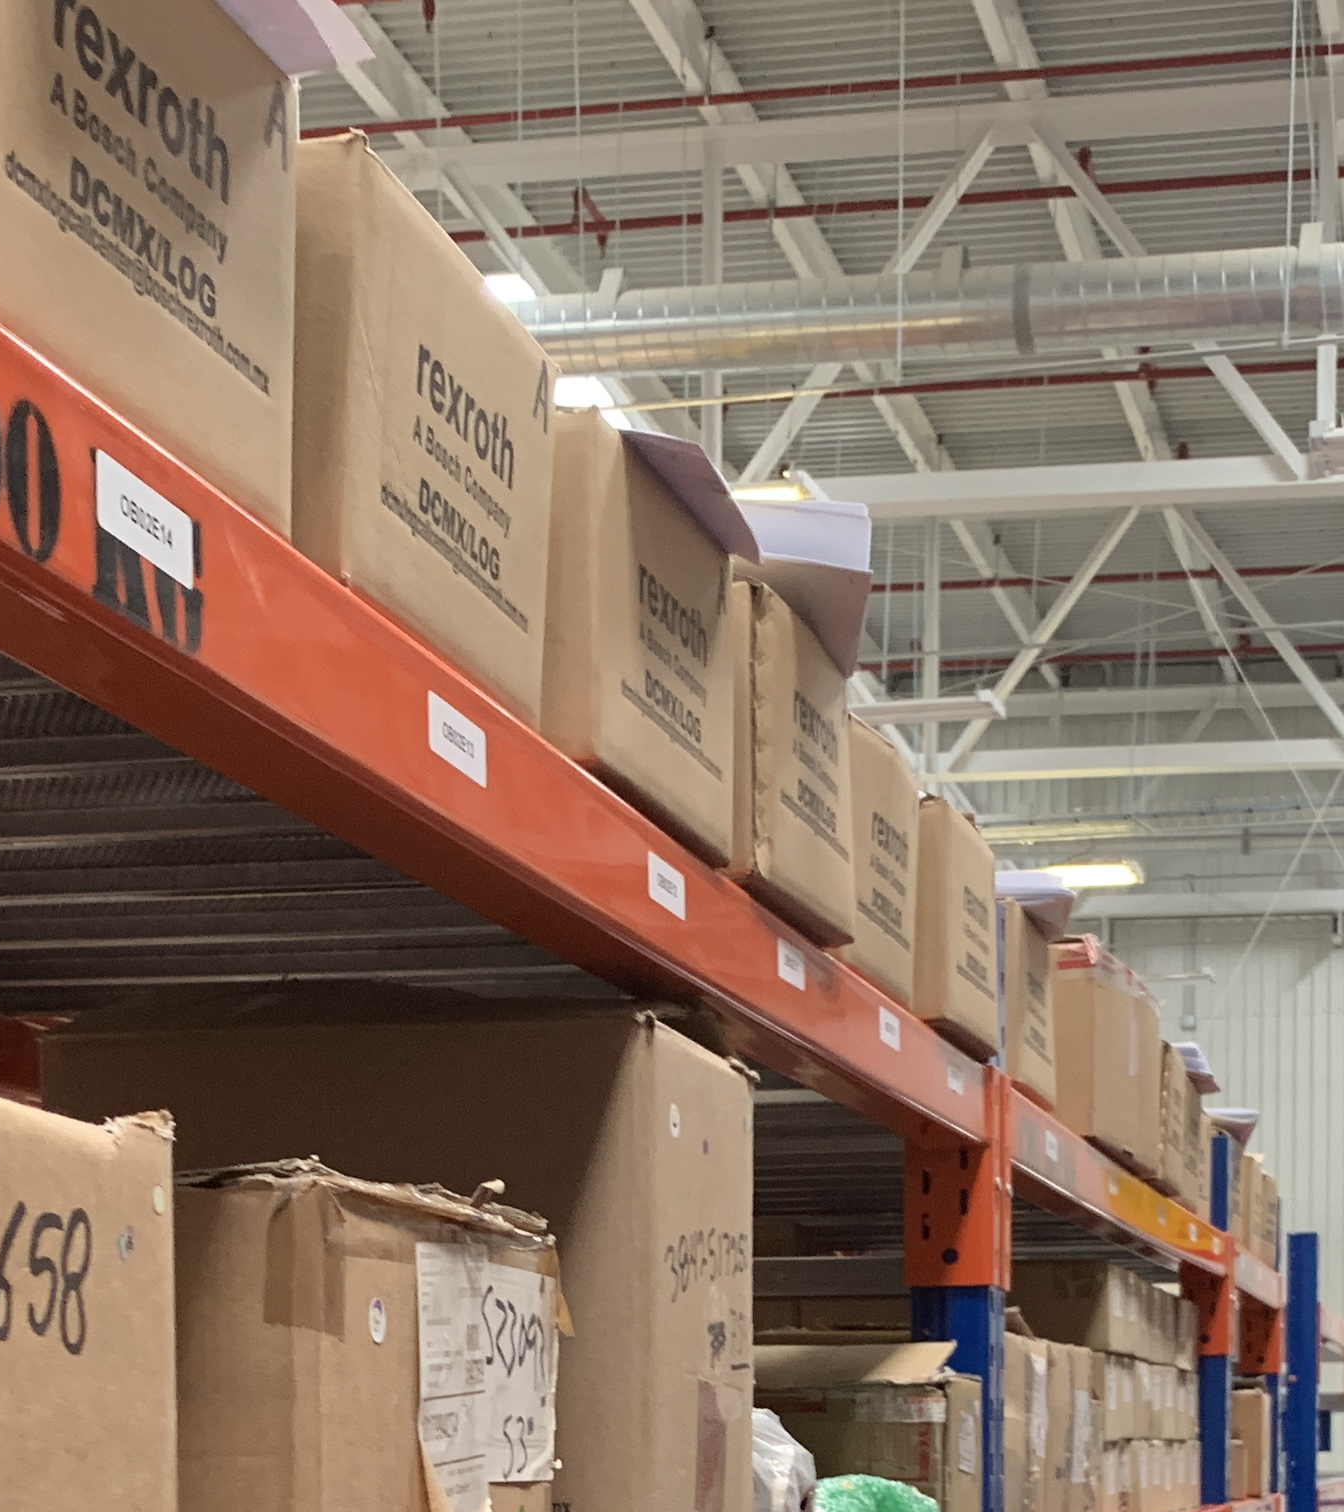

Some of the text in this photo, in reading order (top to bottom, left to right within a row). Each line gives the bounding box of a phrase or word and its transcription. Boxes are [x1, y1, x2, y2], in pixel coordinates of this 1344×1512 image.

[50, 73, 230, 264] A Bosch Company
[53, 0, 230, 205] rexroth
[416, 342, 516, 491] rexroth
[119, 493, 175, 550] OB02E14
